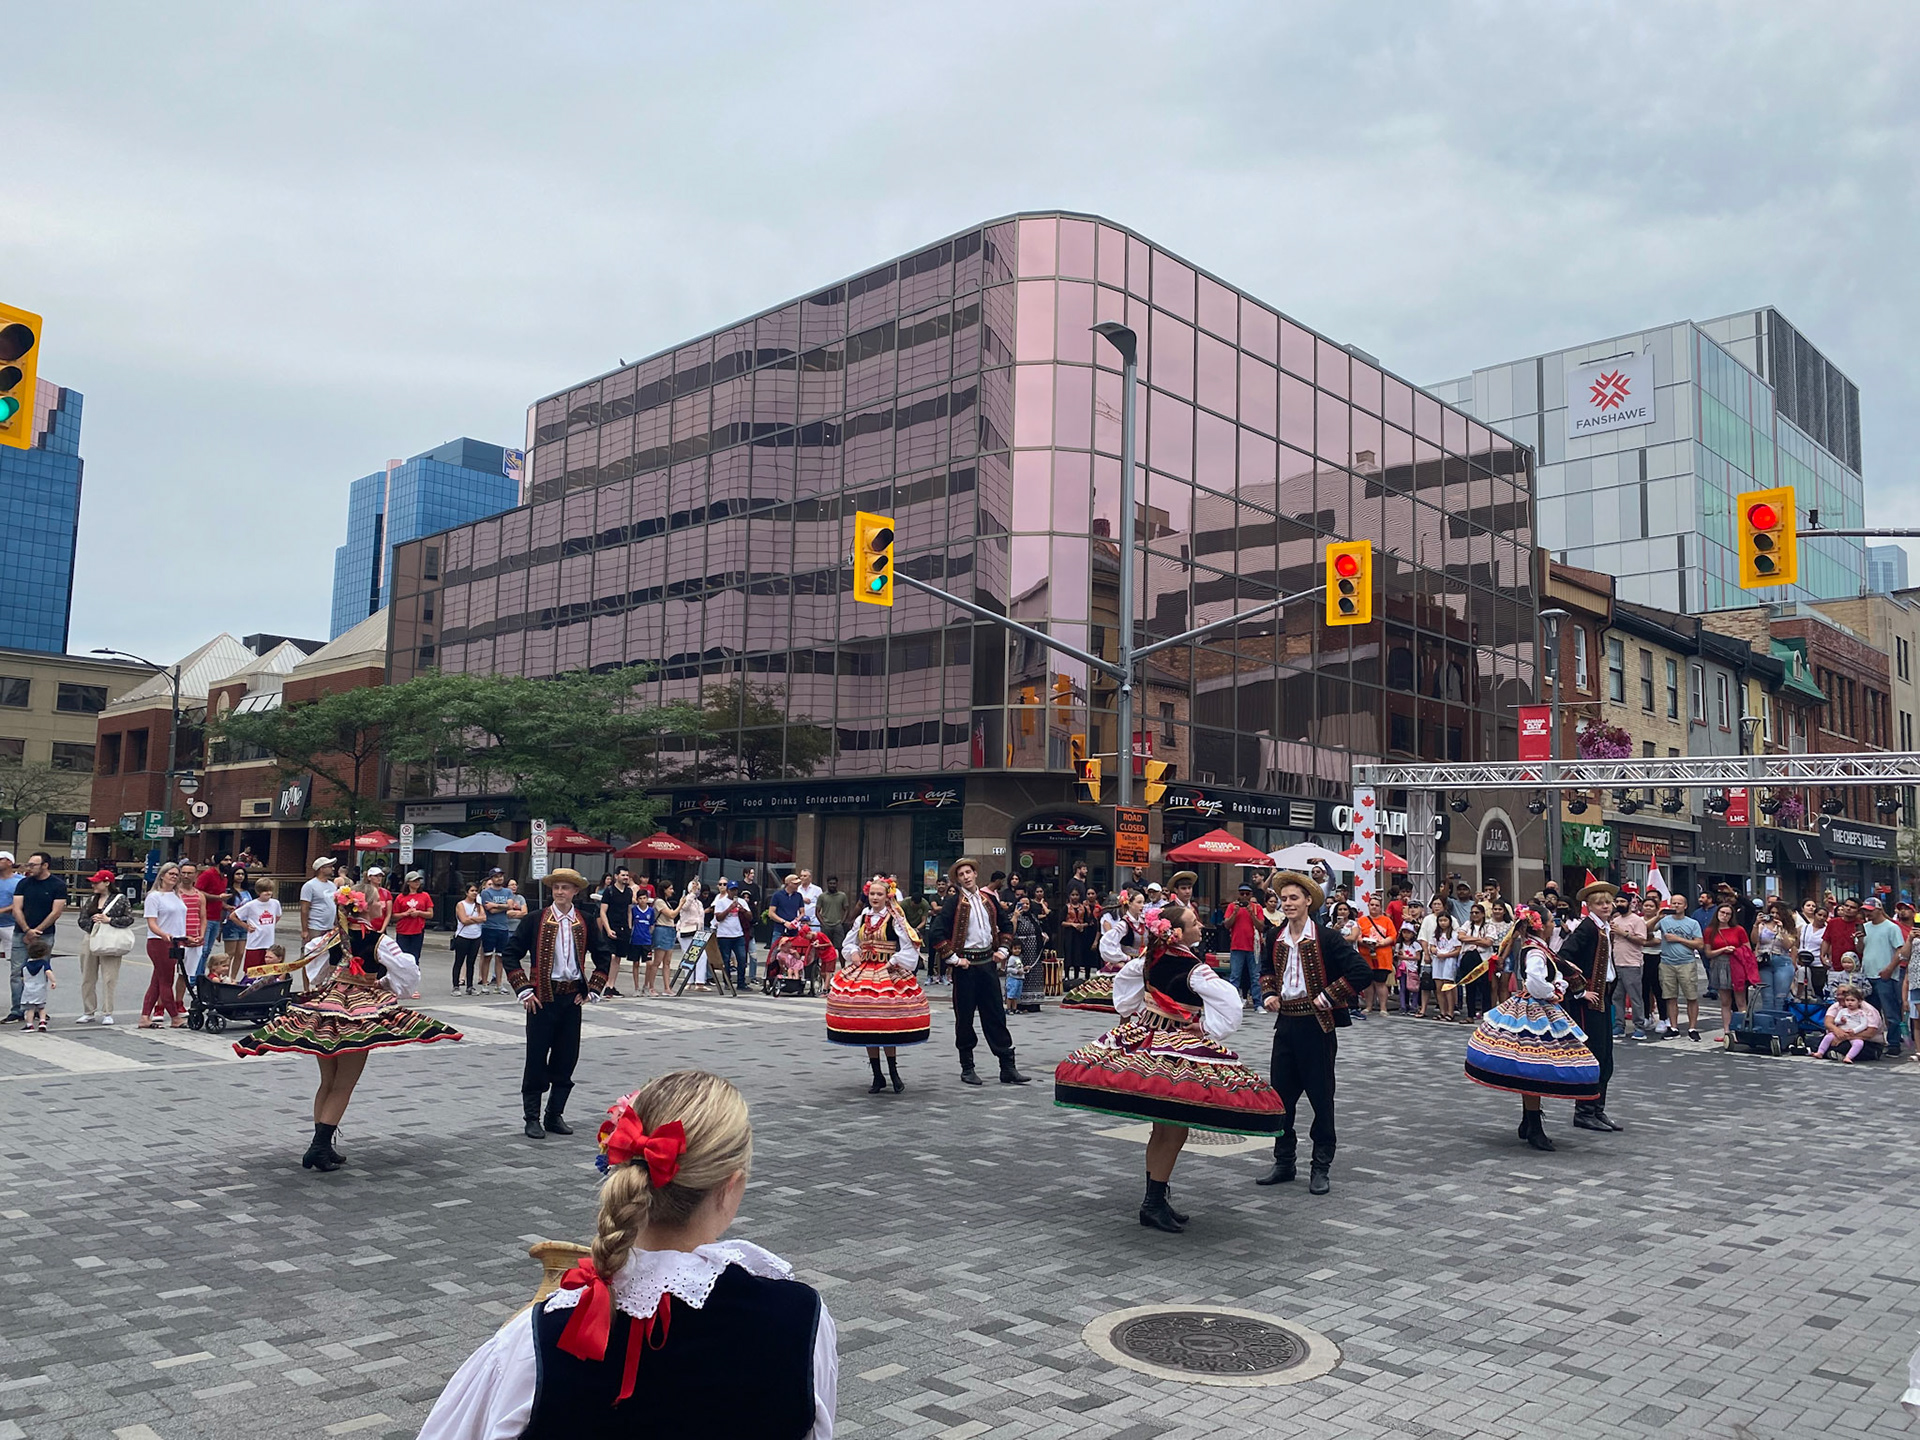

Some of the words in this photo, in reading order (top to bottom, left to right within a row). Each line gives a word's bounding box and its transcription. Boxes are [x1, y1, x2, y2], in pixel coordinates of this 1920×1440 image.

[1576, 407, 1647, 429] FANSHAWE
[742, 798, 763, 807] Food
[771, 797, 798, 806] Drinks
[805, 794, 870, 804] Entertainment
[892, 791, 915, 800] FITZ
[1169, 795, 1189, 806] FITZ
[680, 800, 696, 809] FITZ
[1232, 802, 1281, 816] Restaurant
[150, 813, 162, 824] P
[1123, 813, 1142, 822] ROAD
[1027, 823, 1053, 831] FITZ
[1120, 822, 1146, 832] CLOSED
[1490, 829, 1503, 840] 114
[1832, 829, 1844, 843] THE
[1862, 833, 1878, 848] TABLE
[1486, 840, 1509, 851] DUNDAS
